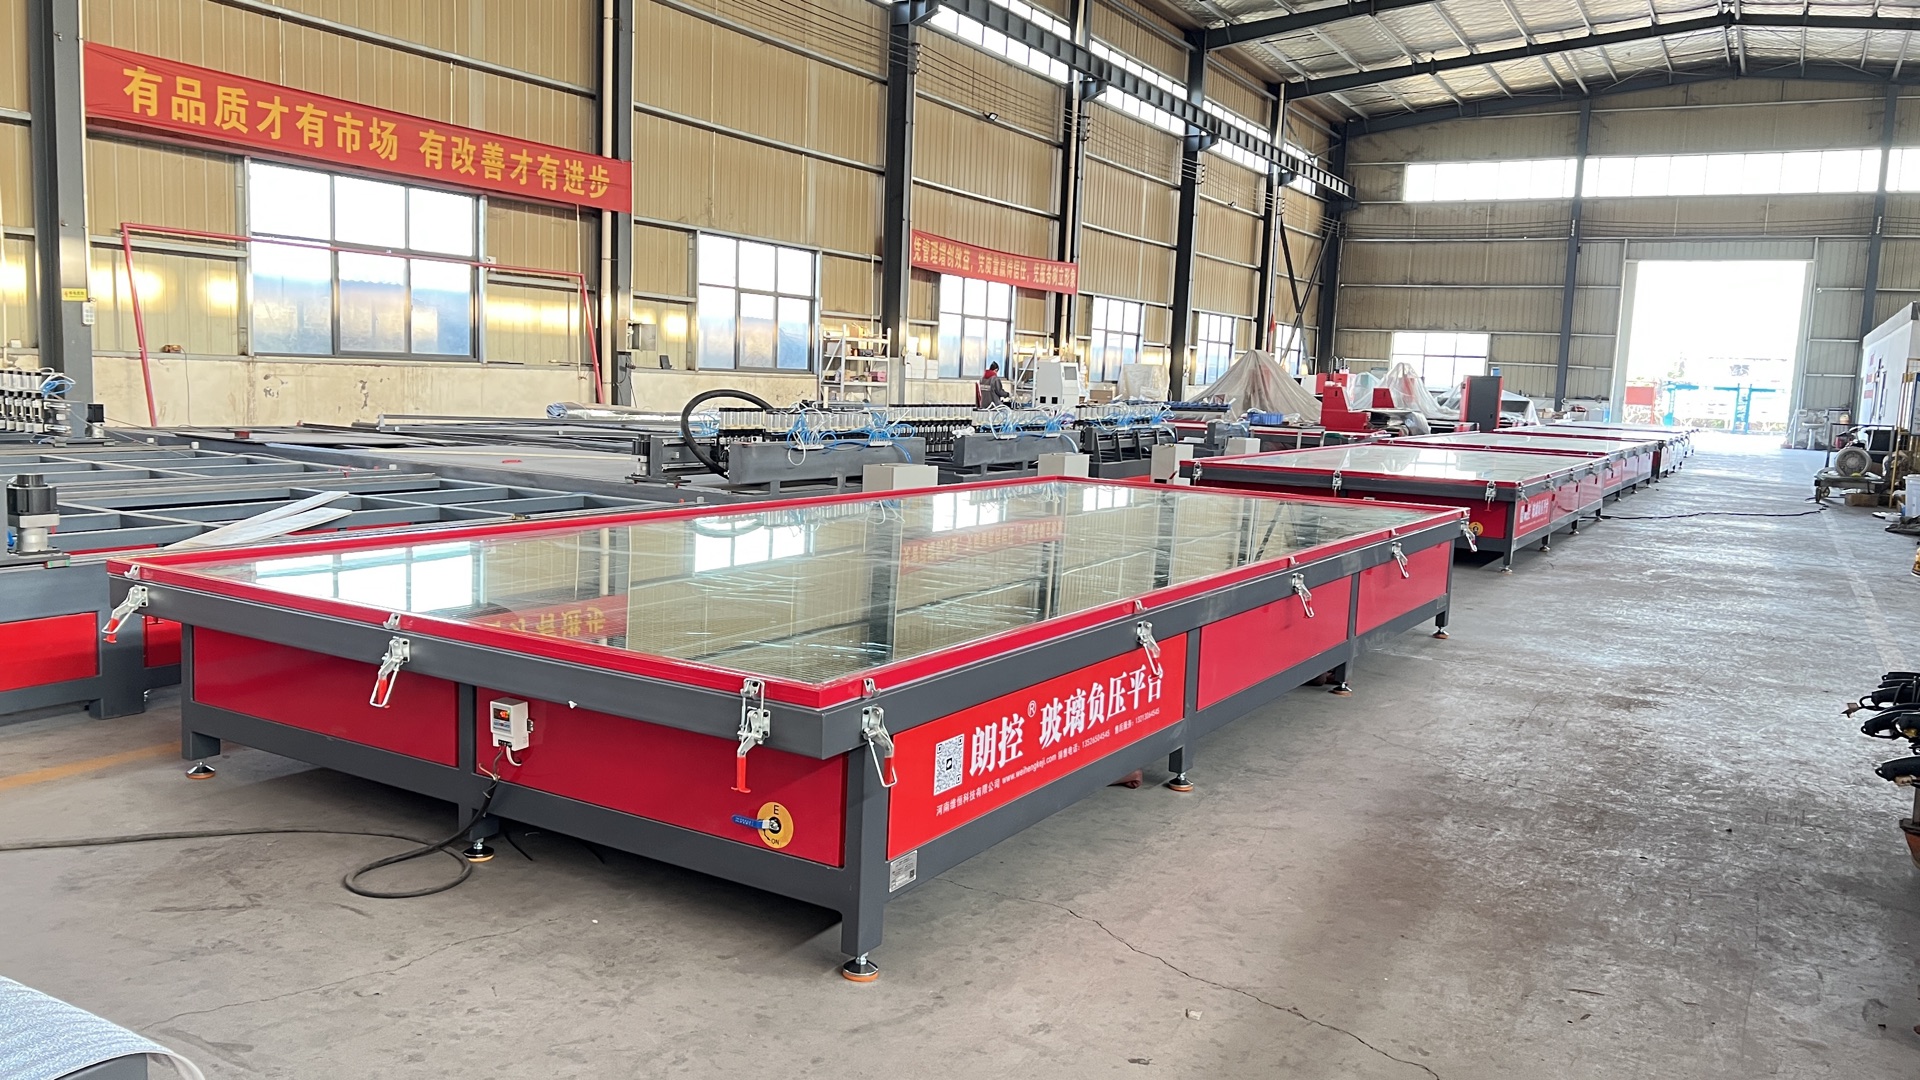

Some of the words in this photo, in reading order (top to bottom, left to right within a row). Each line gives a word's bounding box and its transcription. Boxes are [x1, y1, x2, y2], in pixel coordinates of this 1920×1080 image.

[123, 65, 398, 162] 有品质才有市场
[419, 129, 611, 198] 有改善才有进步
[1039, 664, 1162, 750] 玻璃负压平台
